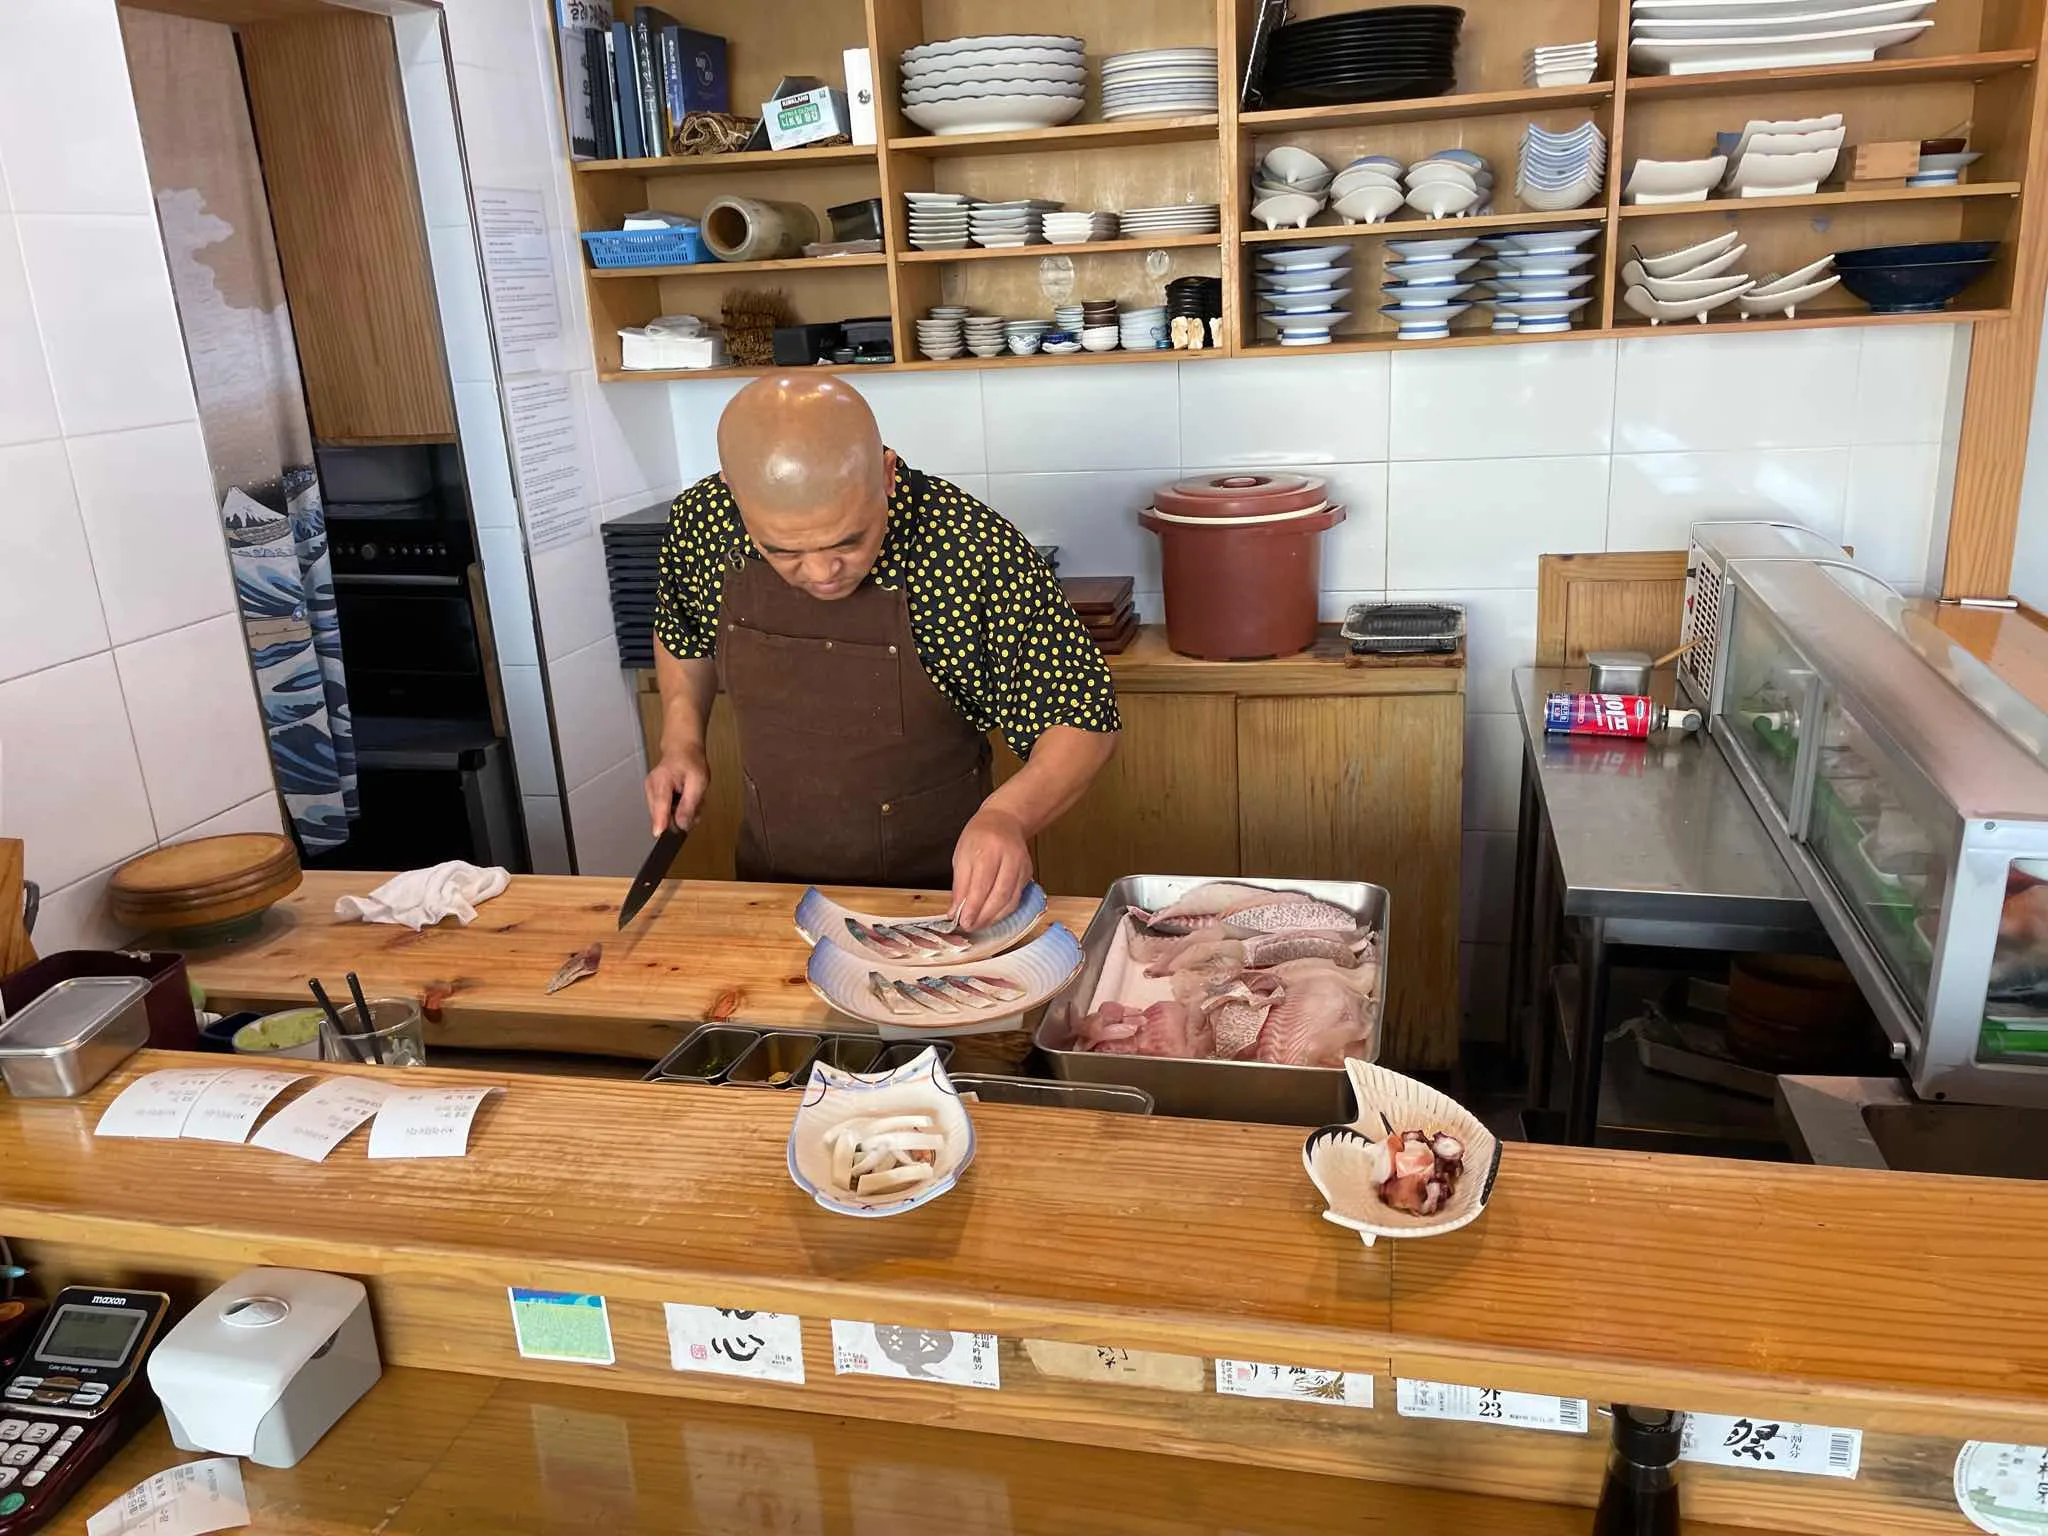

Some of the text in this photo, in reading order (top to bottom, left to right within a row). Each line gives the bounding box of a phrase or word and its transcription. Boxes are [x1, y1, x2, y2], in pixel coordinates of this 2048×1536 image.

[92, 1295, 126, 1306] maxon
[711, 1334, 765, 1362] 心
[1479, 1401, 1503, 1418] 23
[2, 1424, 47, 1439] 2 3
[14, 1450, 28, 1461] 6
